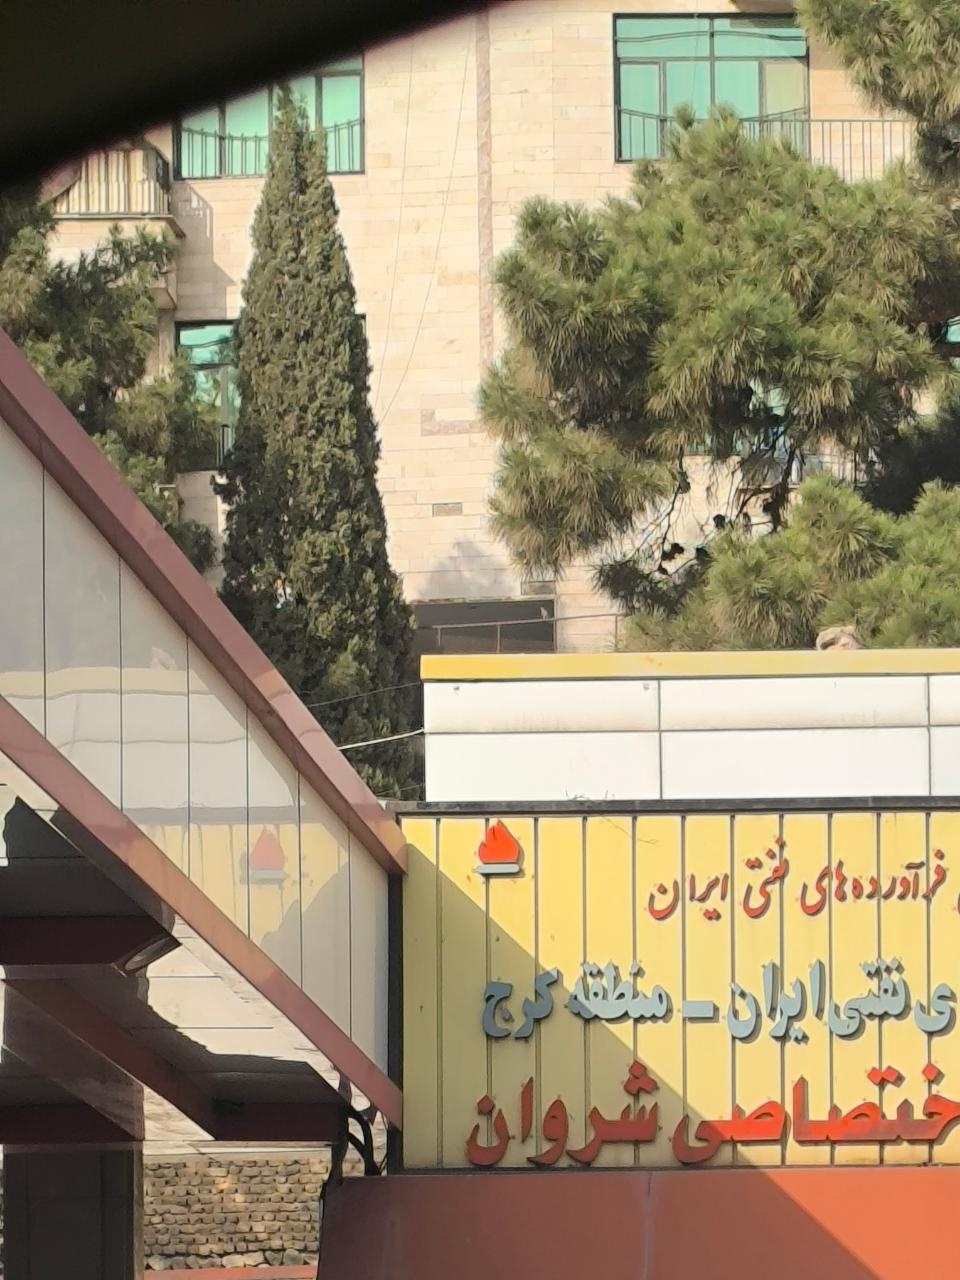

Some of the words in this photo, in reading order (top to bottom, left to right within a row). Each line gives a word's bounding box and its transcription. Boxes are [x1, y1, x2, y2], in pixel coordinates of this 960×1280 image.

[648, 872, 729, 921] ایران
[743, 835, 790, 919] نفتی
[481, 967, 563, 1042] کرج
[565, 959, 672, 1024] منطقه
[726, 958, 826, 1043] ایران
[829, 956, 912, 1039] نفتی
[466, 1059, 660, 1167] شروان
